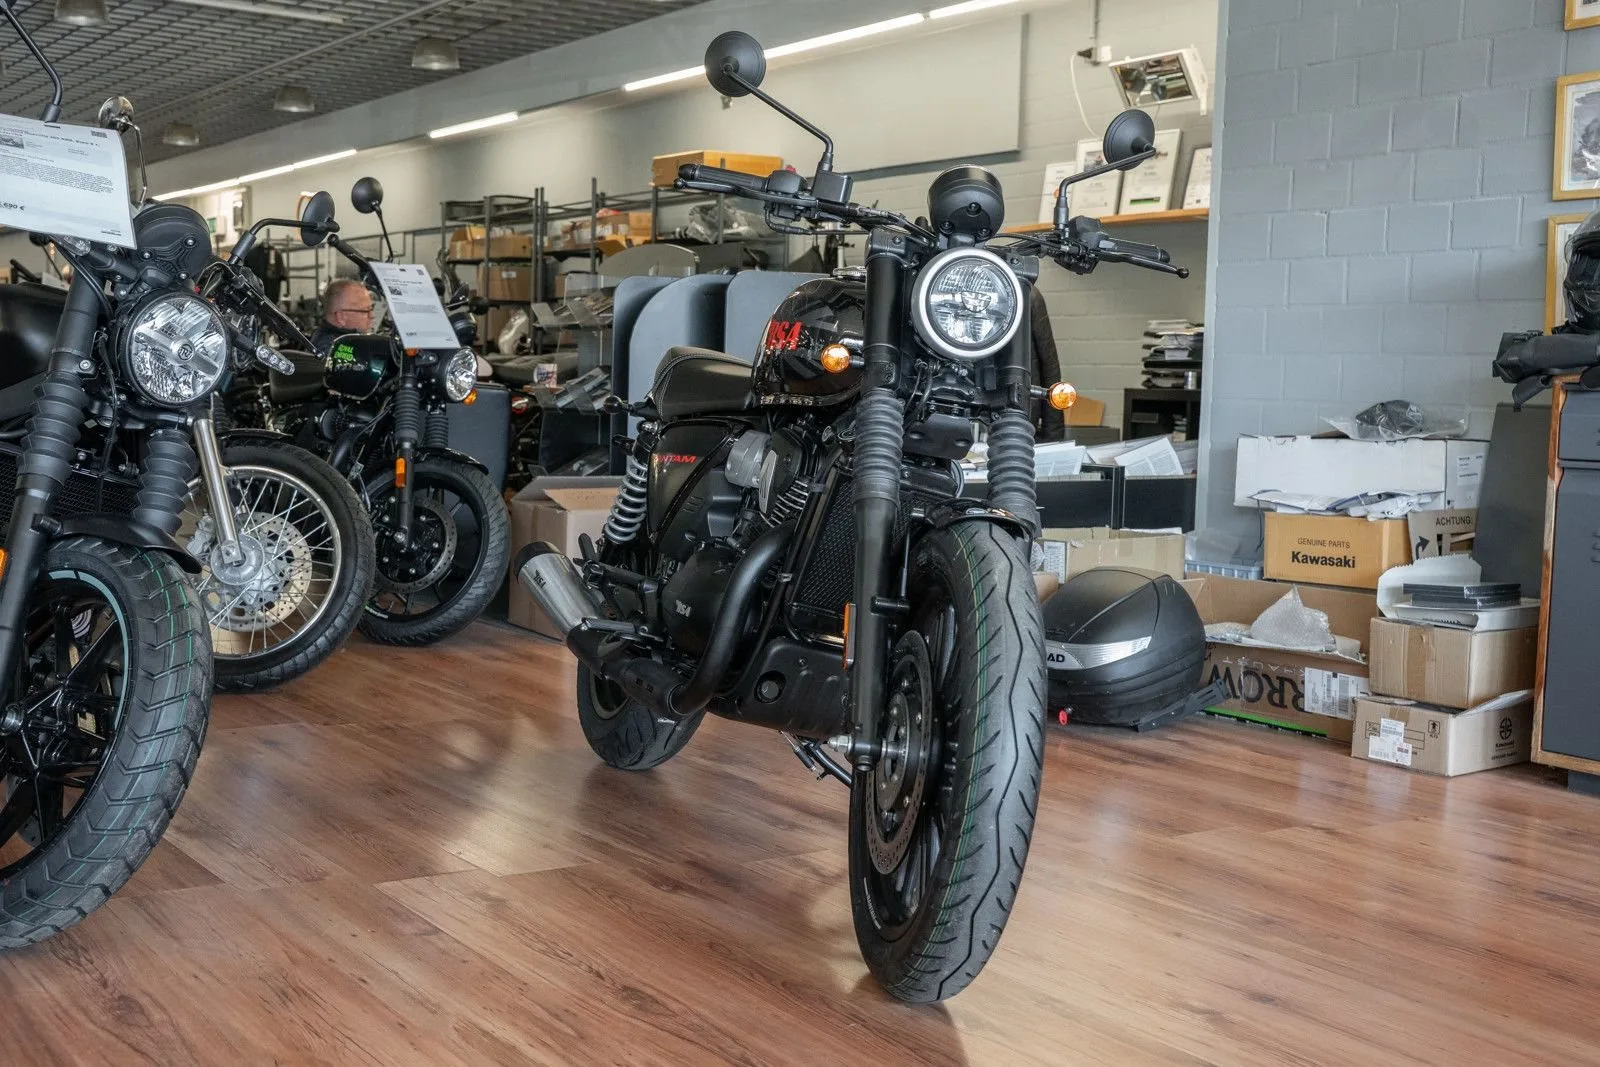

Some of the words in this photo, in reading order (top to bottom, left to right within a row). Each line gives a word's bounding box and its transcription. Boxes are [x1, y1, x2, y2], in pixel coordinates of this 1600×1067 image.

[1297, 537, 1327, 548] GENUINE
[1328, 540, 1351, 549] PARTS
[1291, 551, 1356, 569] Kawasaki
